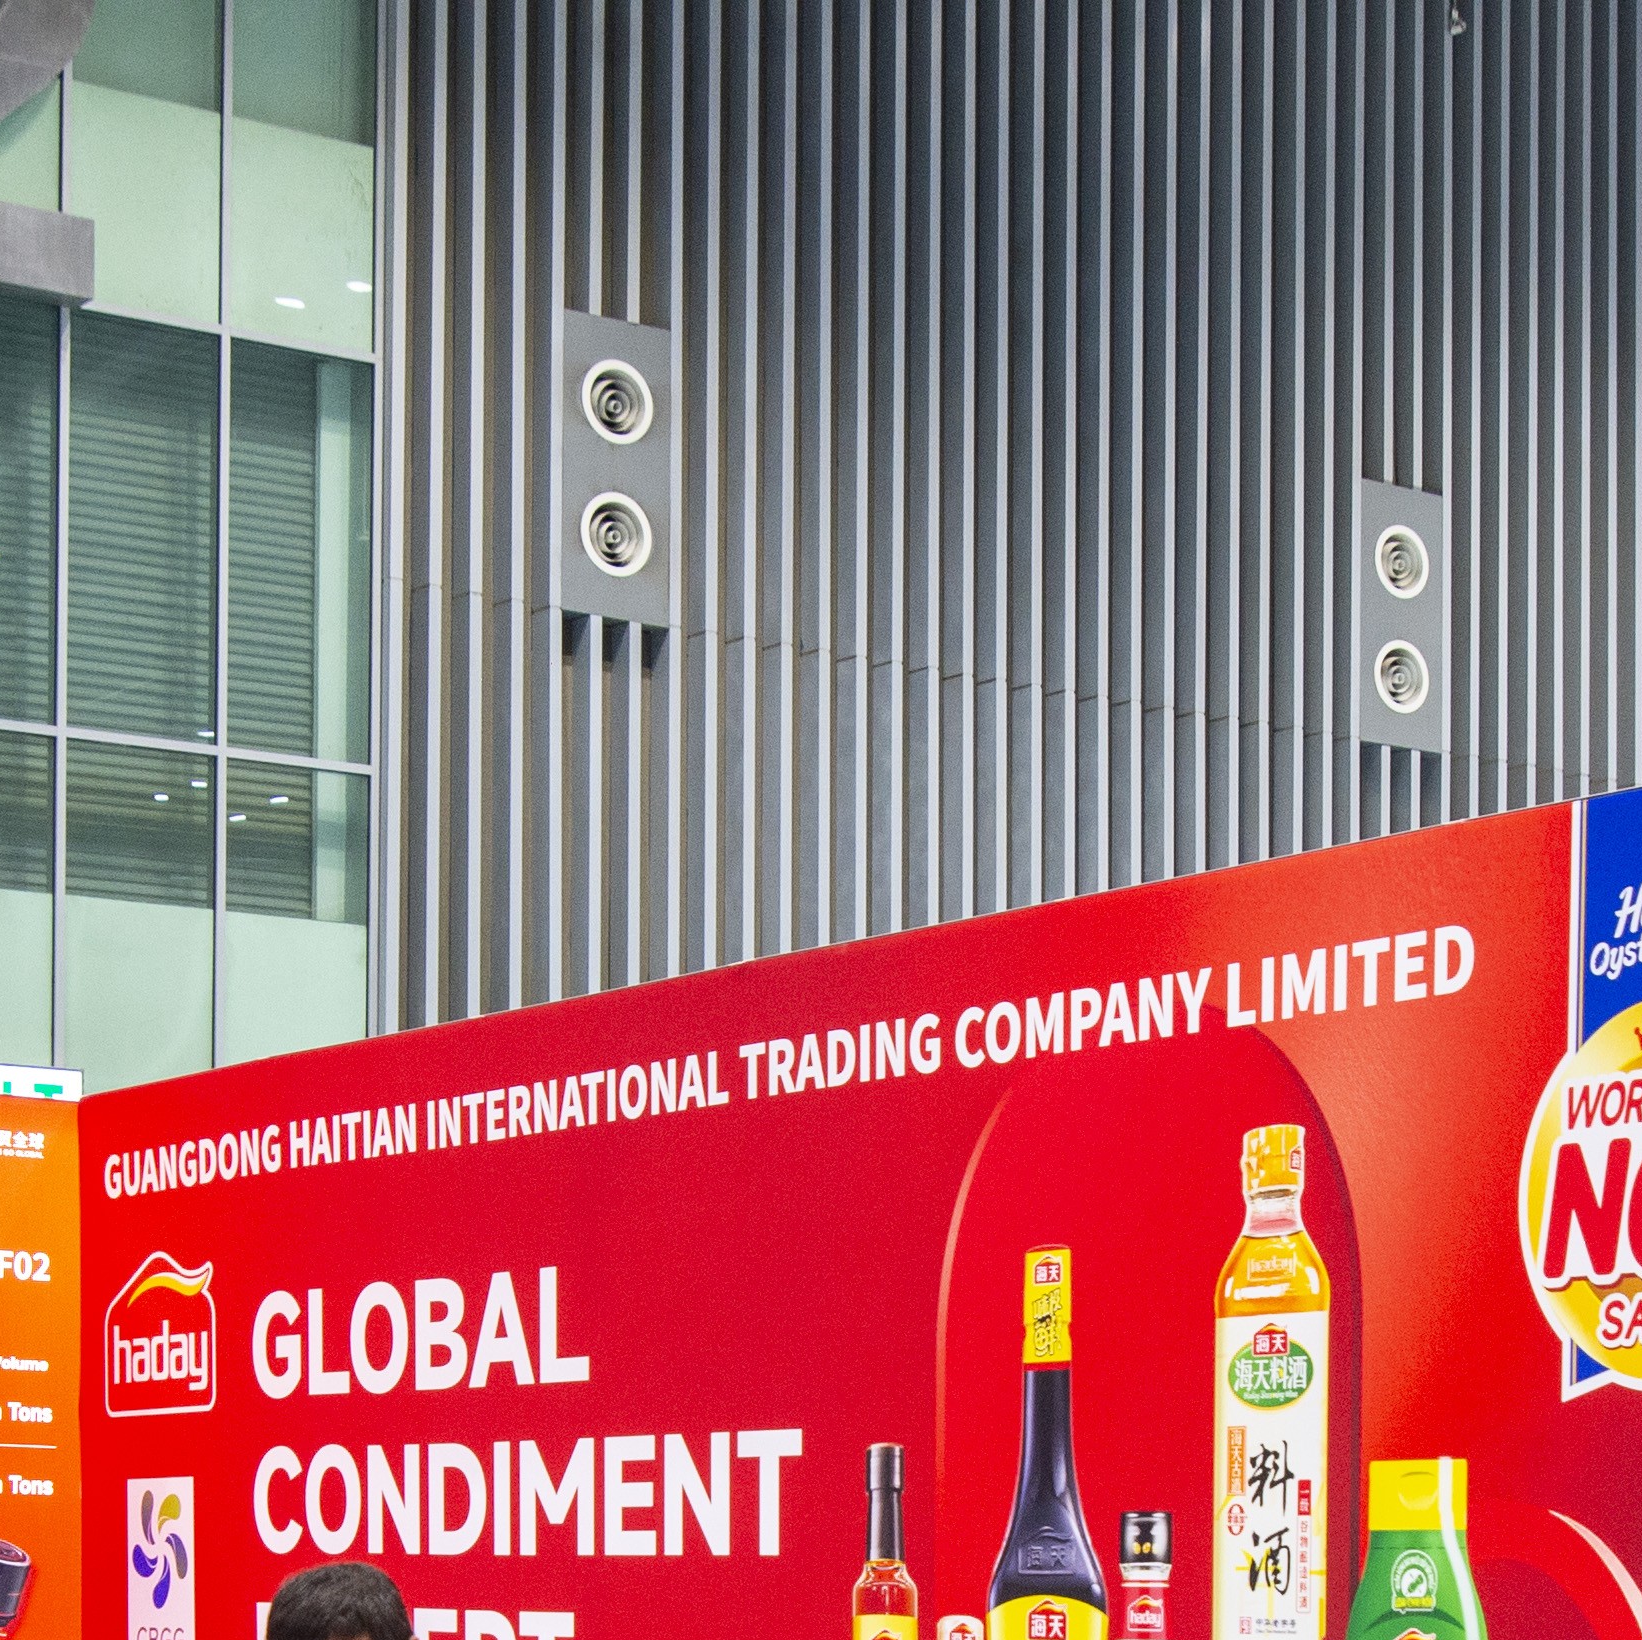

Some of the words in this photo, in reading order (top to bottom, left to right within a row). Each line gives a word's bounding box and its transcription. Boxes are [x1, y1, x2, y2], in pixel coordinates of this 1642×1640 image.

[103, 1124, 282, 1200] GUANGDONG
[288, 1103, 417, 1169] HAITIAN
[426, 1051, 729, 1150] INTERNATIONAL
[739, 1013, 942, 1099] TRADING
[955, 967, 1212, 1069] COMPANY
[1226, 924, 1476, 1028] LIMITED
[252, 1265, 590, 1401] GLOBAL
[1256, 1334, 1286, 1353] 海天
[112, 1321, 209, 1393] haday
[1234, 1356, 1307, 1391] 海天料酒
[7, 1401, 53, 1423] Tons
[8, 1474, 54, 1496] Tons
[253, 1428, 804, 1557] CONDIMENT
[1031, 1614, 1064, 1638] 海天
